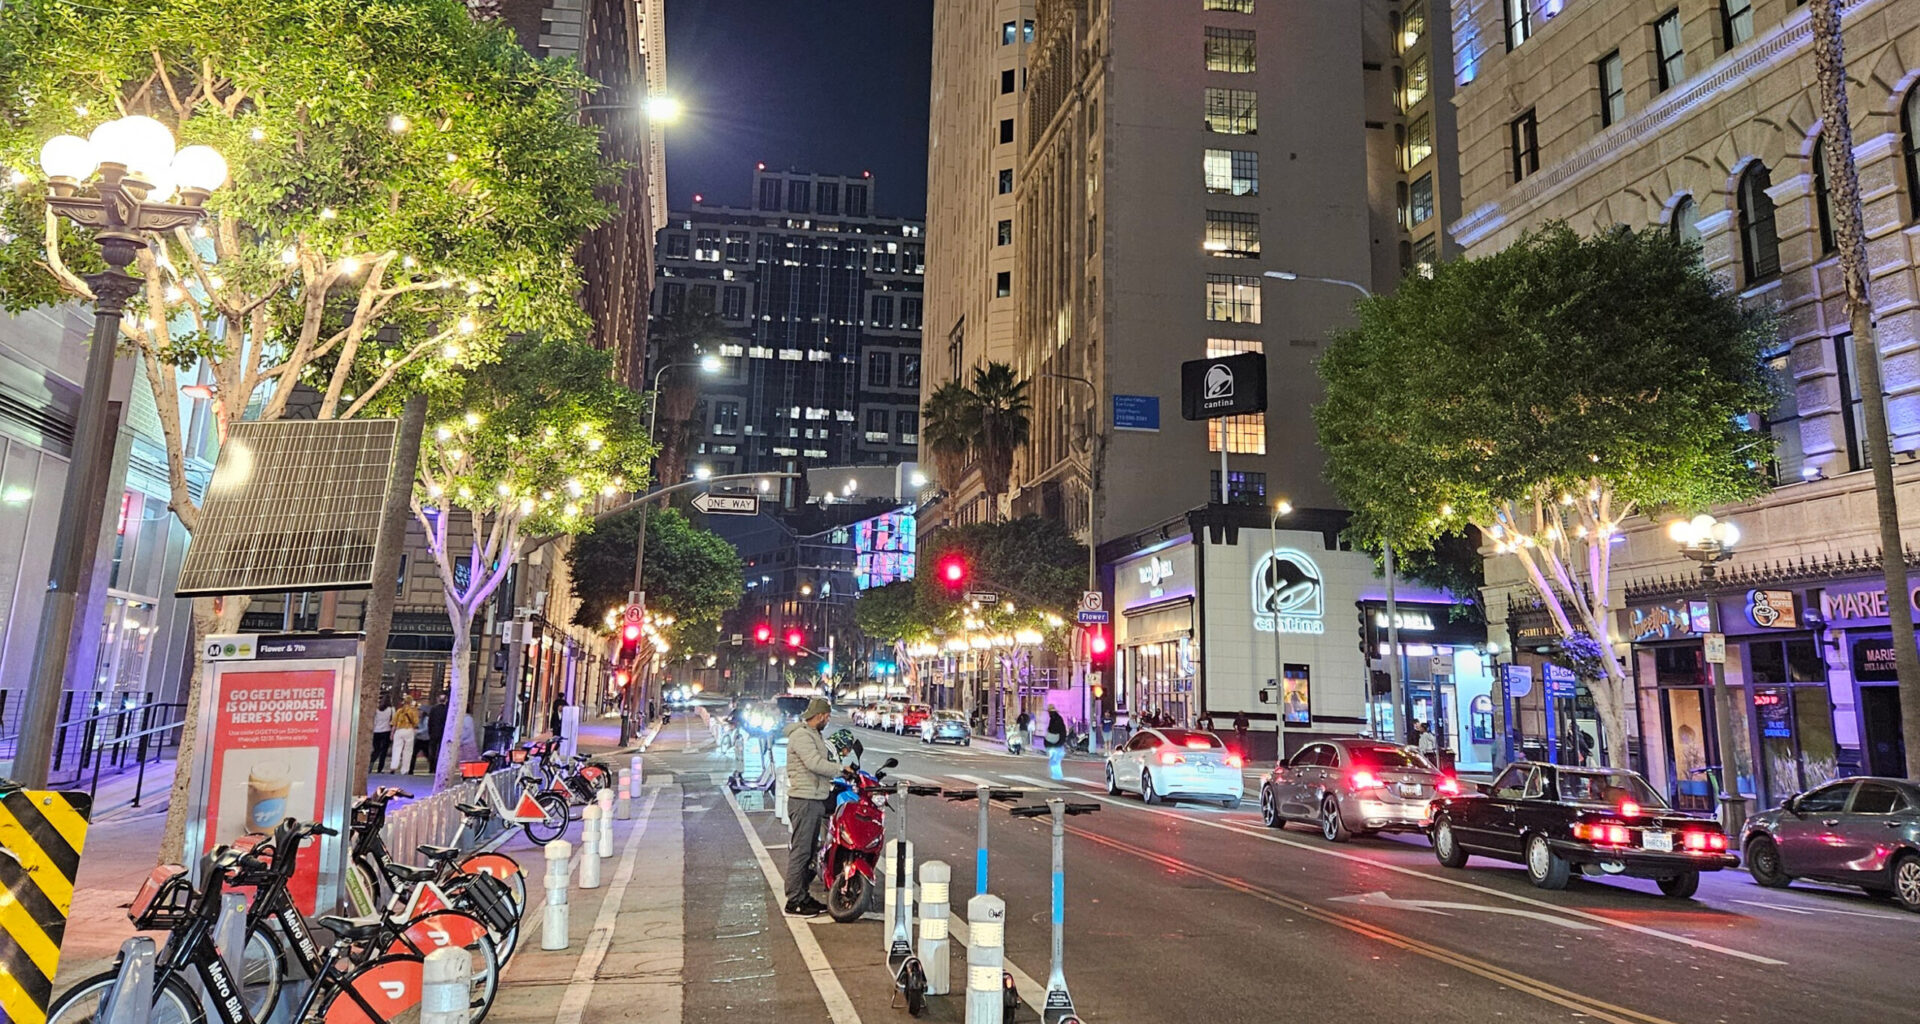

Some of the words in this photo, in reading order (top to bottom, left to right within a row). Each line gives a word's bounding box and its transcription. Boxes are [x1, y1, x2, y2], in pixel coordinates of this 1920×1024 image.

[1204, 400, 1234, 409] cantina
[707, 498, 726, 508] ONE
[732, 499, 752, 508] WAY
[418, 622, 451, 632] Cuisin
[1255, 617, 1324, 634] cantina
[230, 690, 248, 700] GO
[249, 689, 272, 700] GET
[273, 689, 292, 699] EM
[292, 687, 325, 699] TIGER
[226, 702, 238, 712] IS
[239, 701, 257, 712] ON
[259, 699, 328, 711] DOORDASH.
[231, 712, 272, 724] HERE'S
[274, 711, 293, 724] $10
[294, 710, 319, 721] OFF.
[283, 908, 303, 939] Metro
[298, 939, 315, 962] Bike
[207, 960, 230, 998] Metro
[225, 995, 243, 1024] Bike
